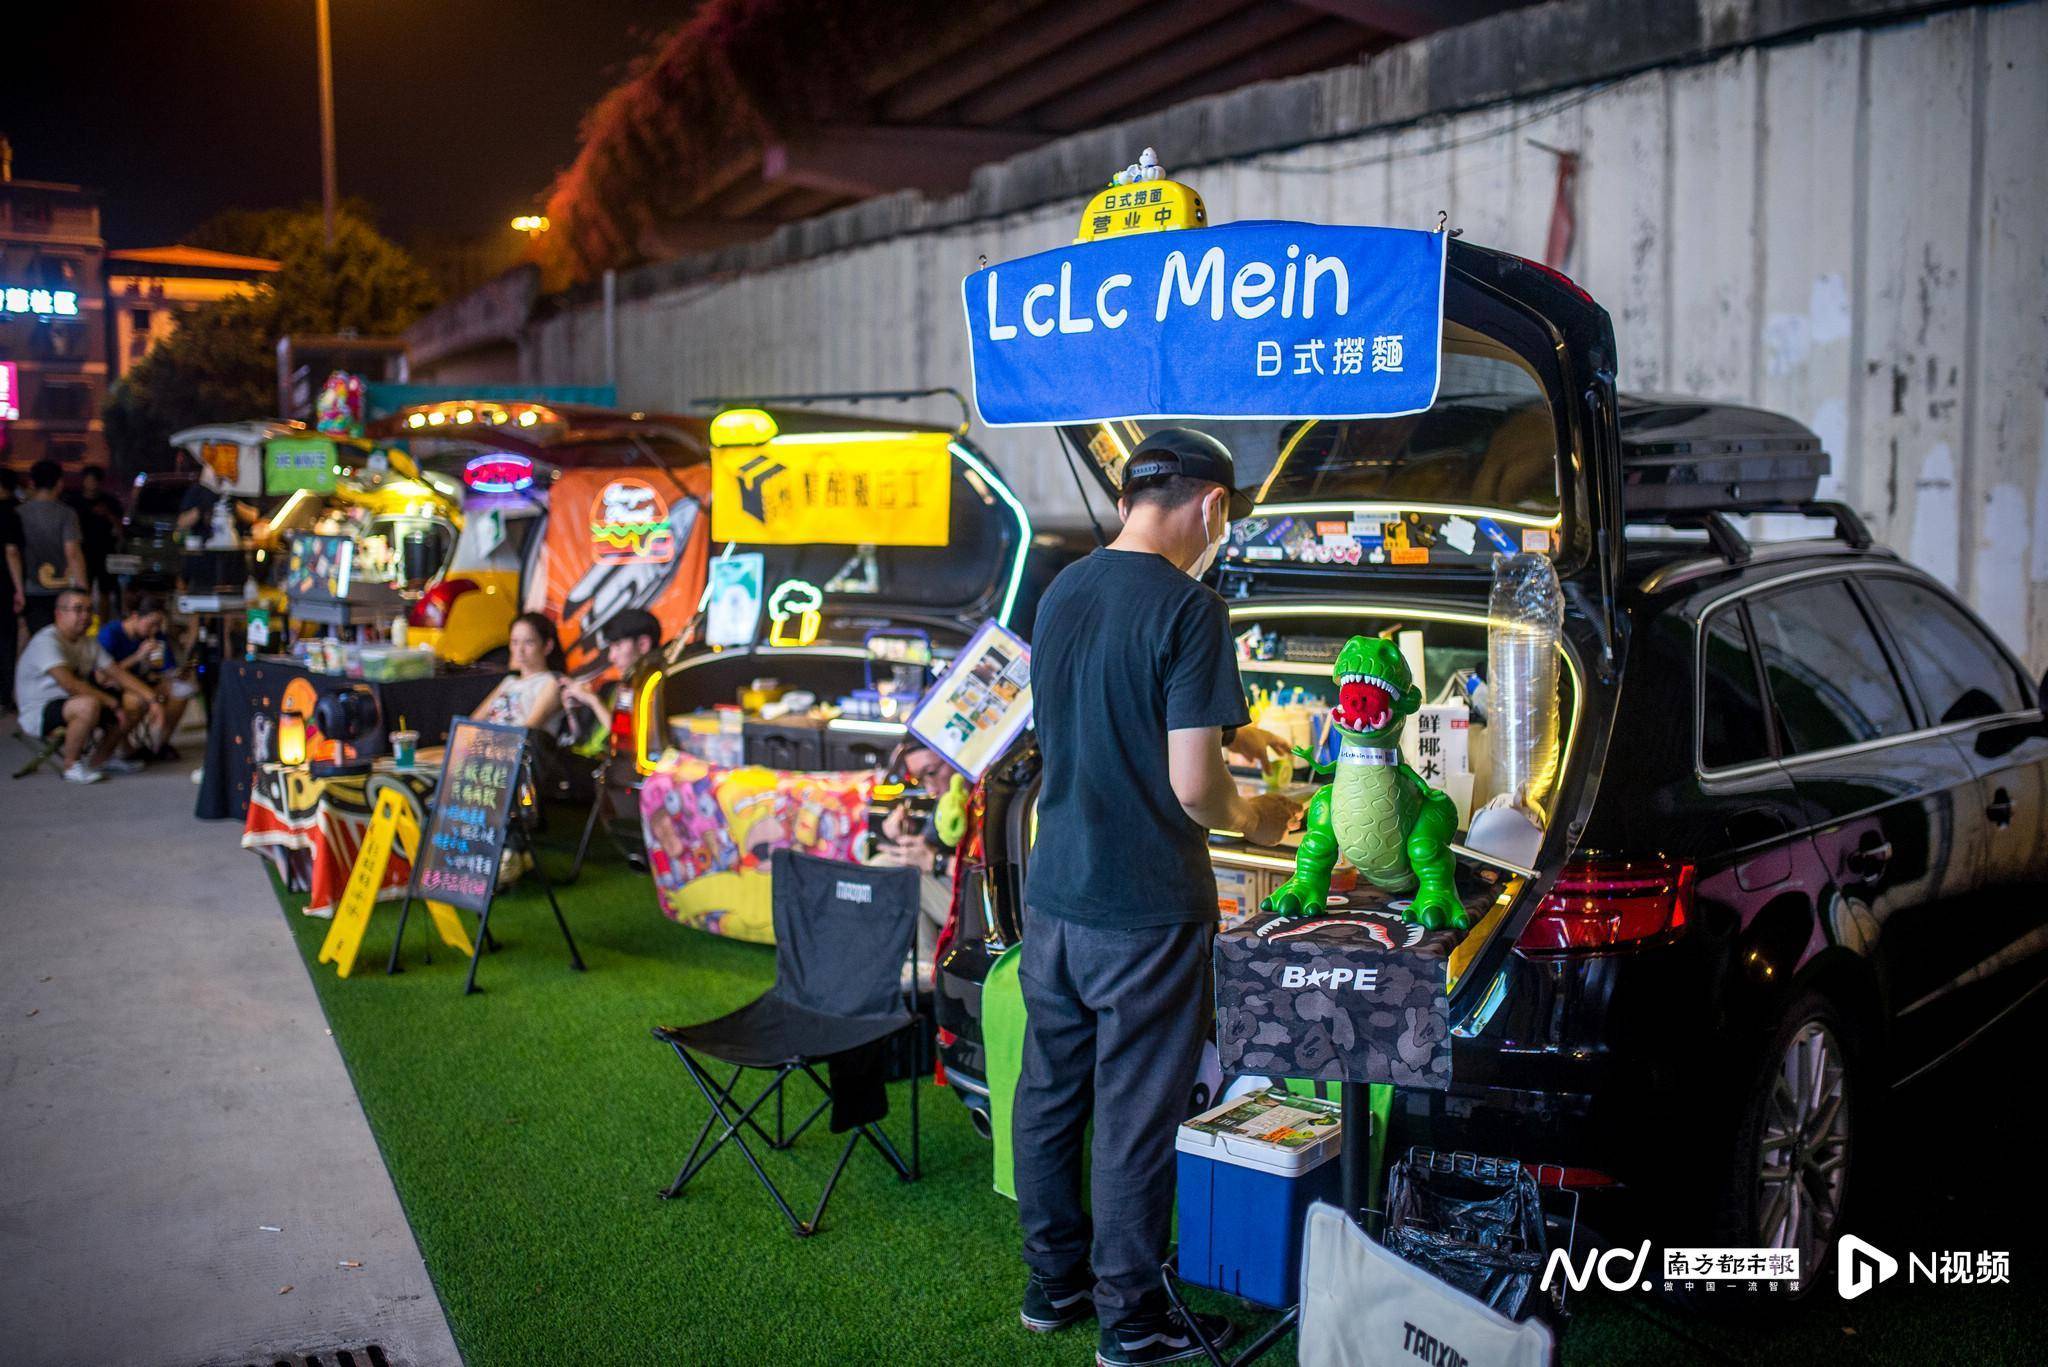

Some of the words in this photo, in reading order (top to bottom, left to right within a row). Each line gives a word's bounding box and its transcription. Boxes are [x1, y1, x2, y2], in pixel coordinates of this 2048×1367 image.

[1092, 207, 1172, 234] 营业中
[988, 261, 1132, 342] LcLc
[1155, 243, 1350, 323] Mein
[1256, 334, 1405, 377] 日式撈麵
[1418, 714, 1441, 780] 鲜椰水
